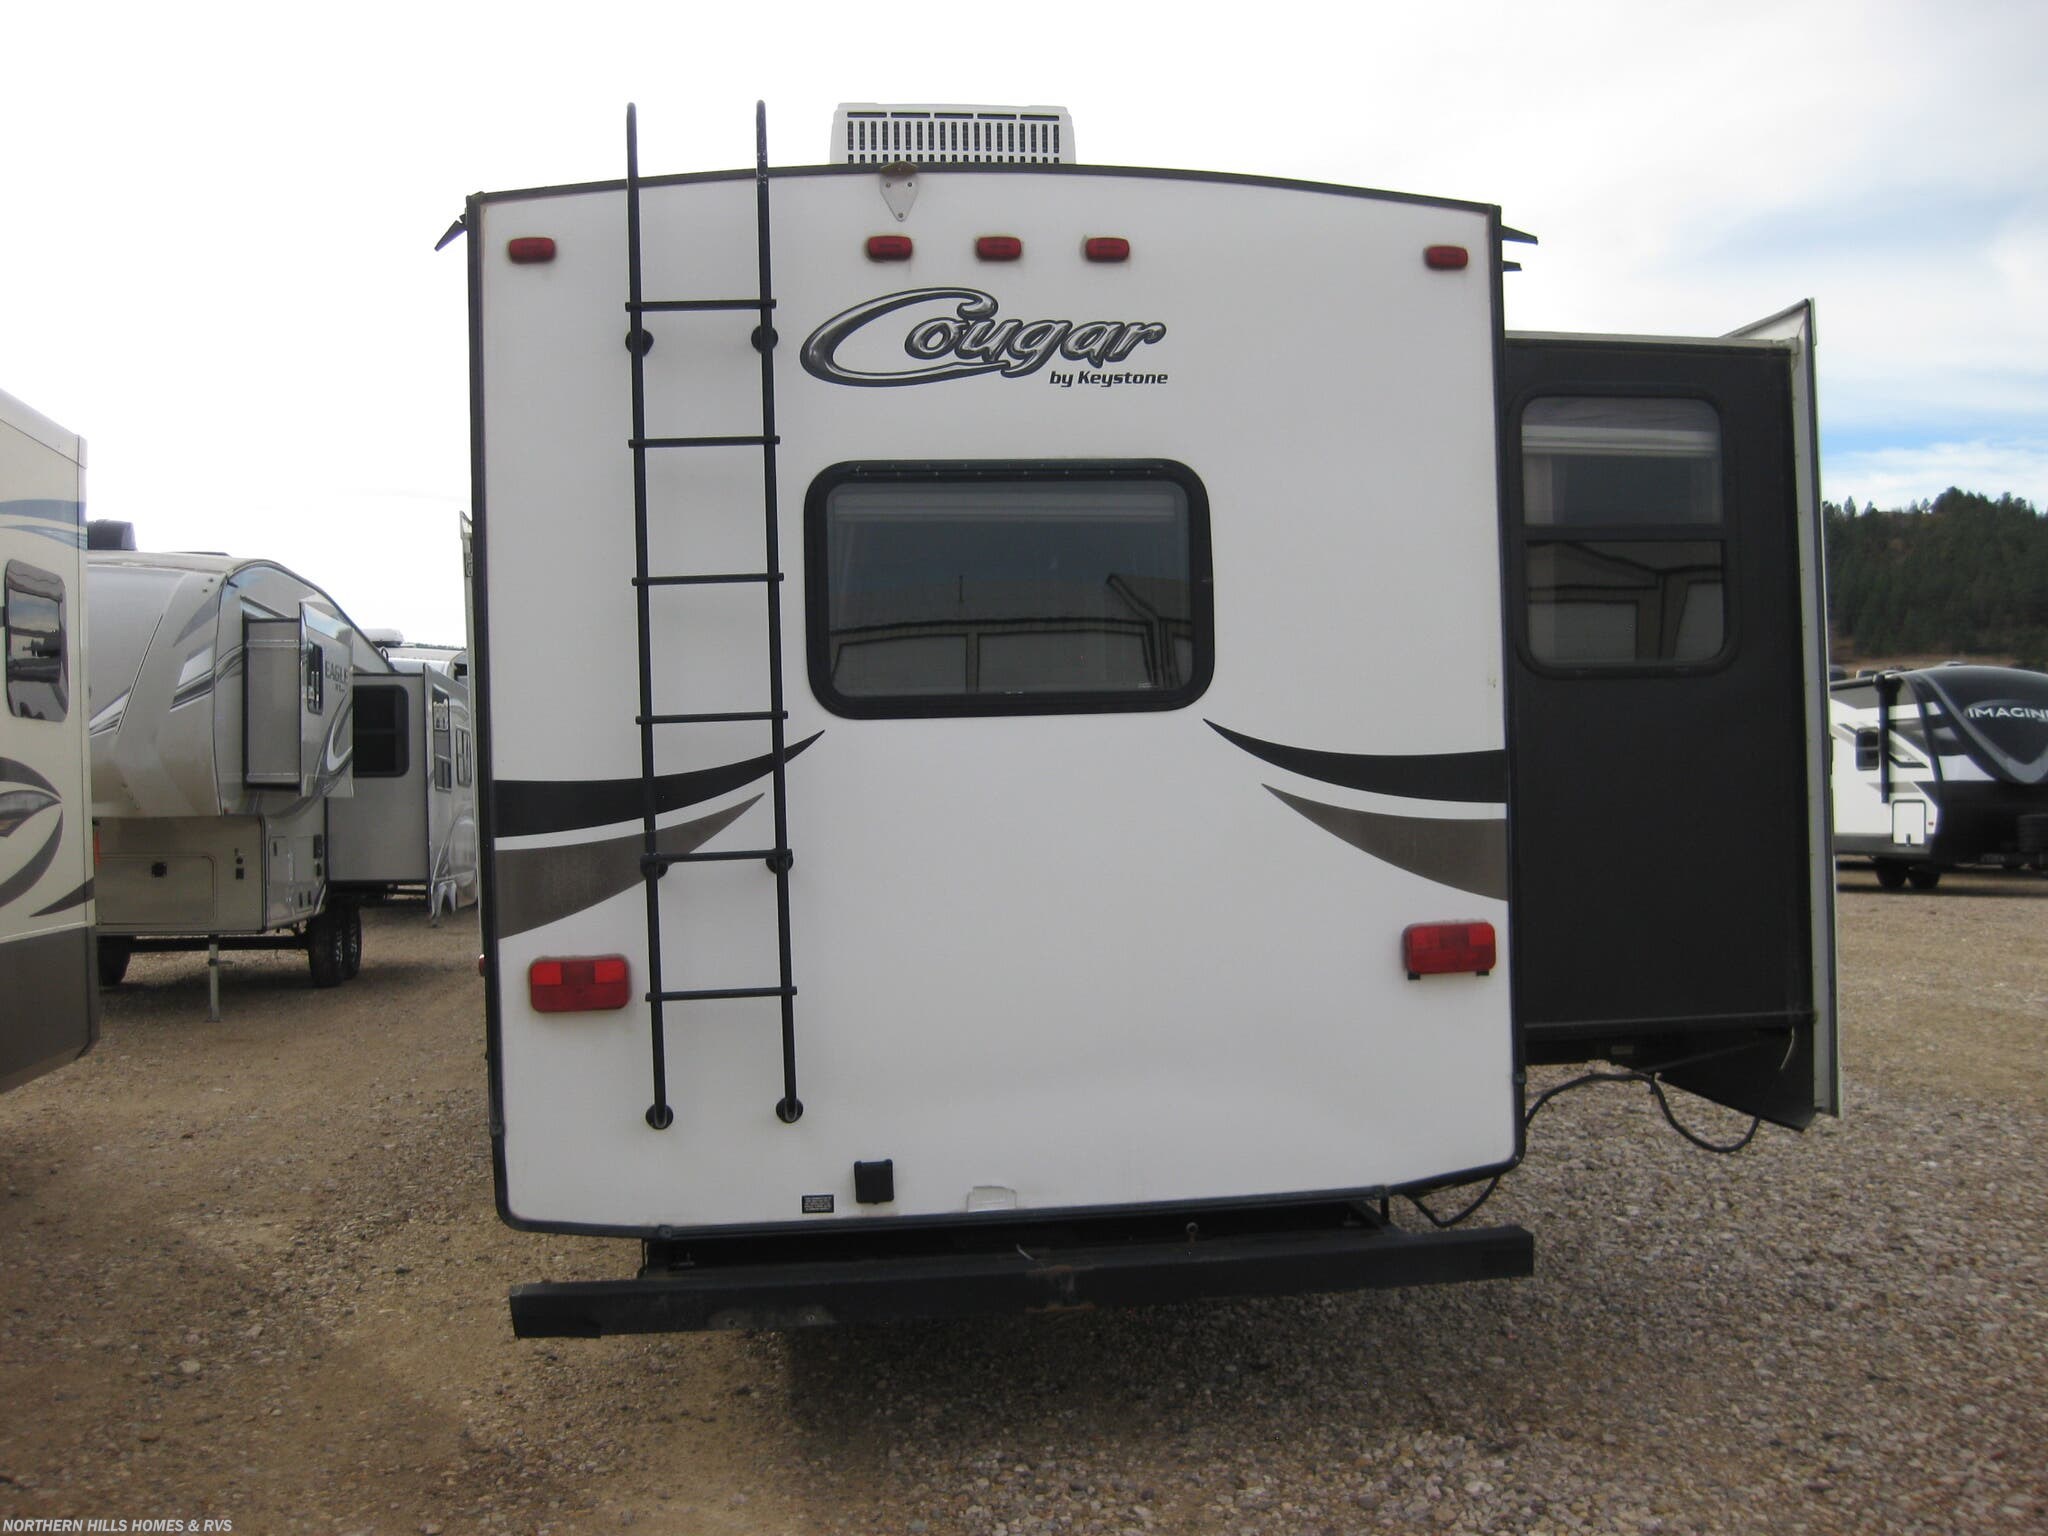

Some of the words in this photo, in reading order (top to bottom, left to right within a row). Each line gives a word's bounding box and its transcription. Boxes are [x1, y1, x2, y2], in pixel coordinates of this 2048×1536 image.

[800, 287, 1166, 387] Cougar
[1049, 371, 1073, 388] by
[1077, 371, 1168, 388] Keystone
[1968, 707, 2048, 719] IMAGIN
